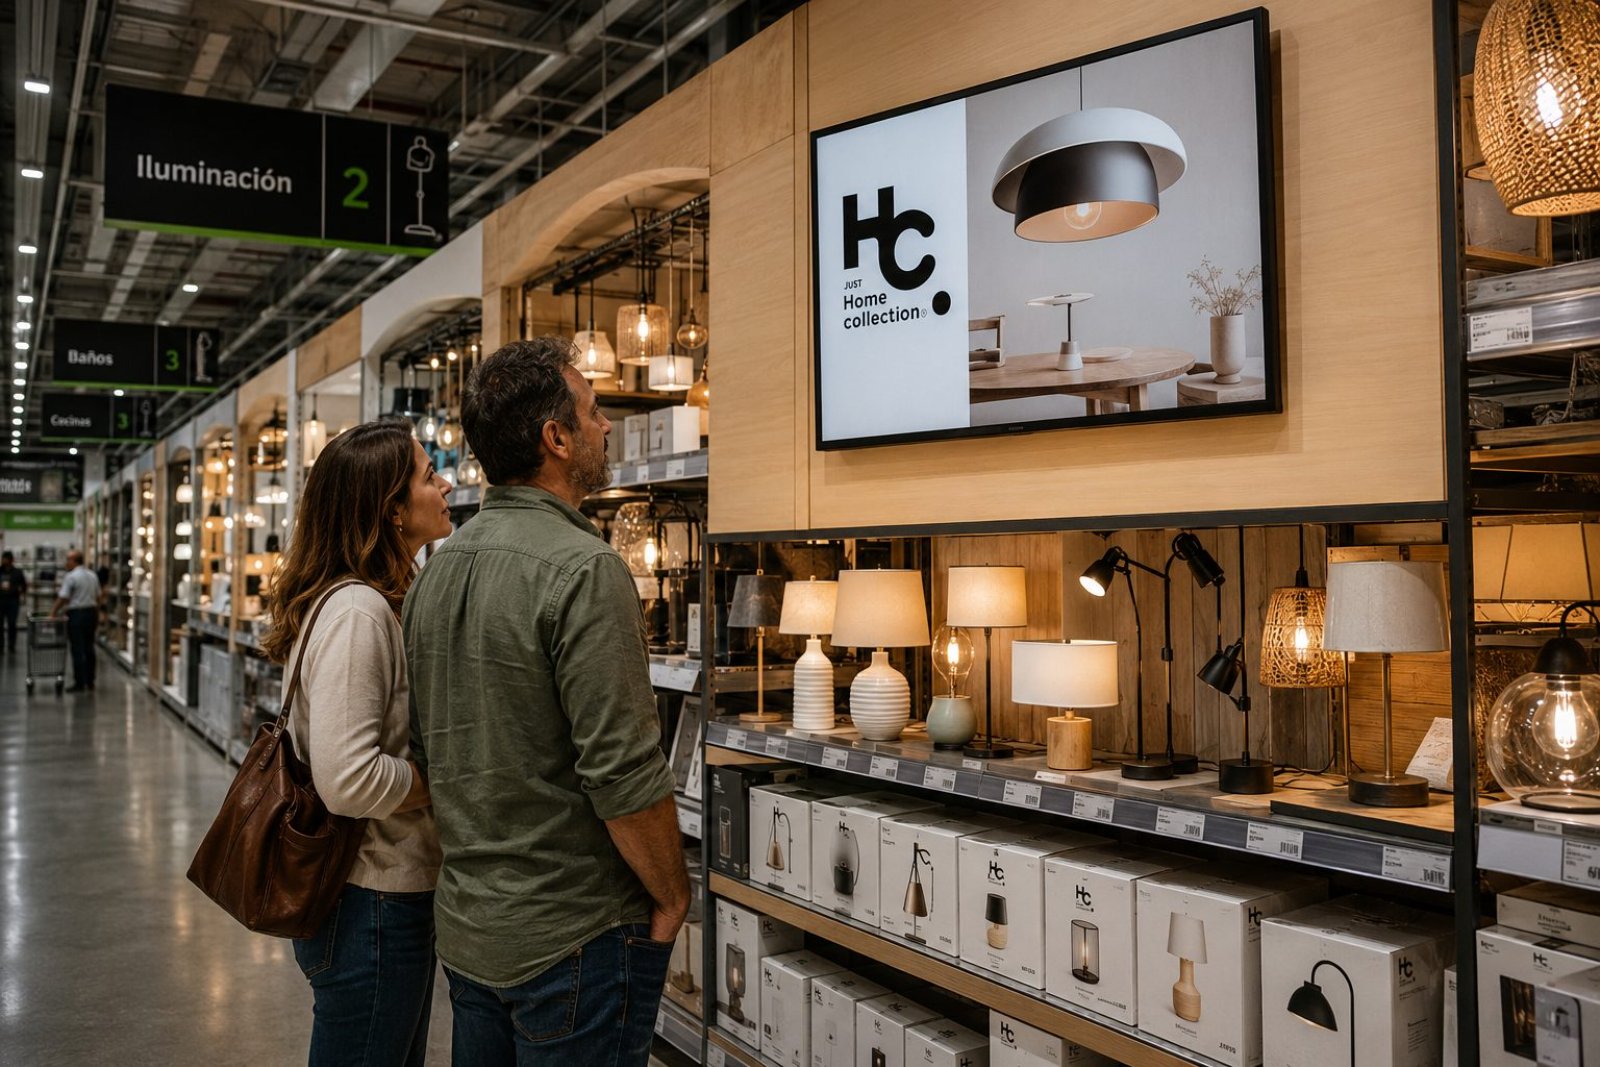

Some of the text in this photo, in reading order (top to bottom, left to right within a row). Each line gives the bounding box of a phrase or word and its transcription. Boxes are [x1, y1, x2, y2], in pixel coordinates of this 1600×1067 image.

[137, 154, 369, 209] Iluminación 2
[844, 279, 863, 290] JUST
[844, 293, 887, 310] Home
[68, 350, 179, 371] Baños 3
[117, 413, 128, 430] 3
